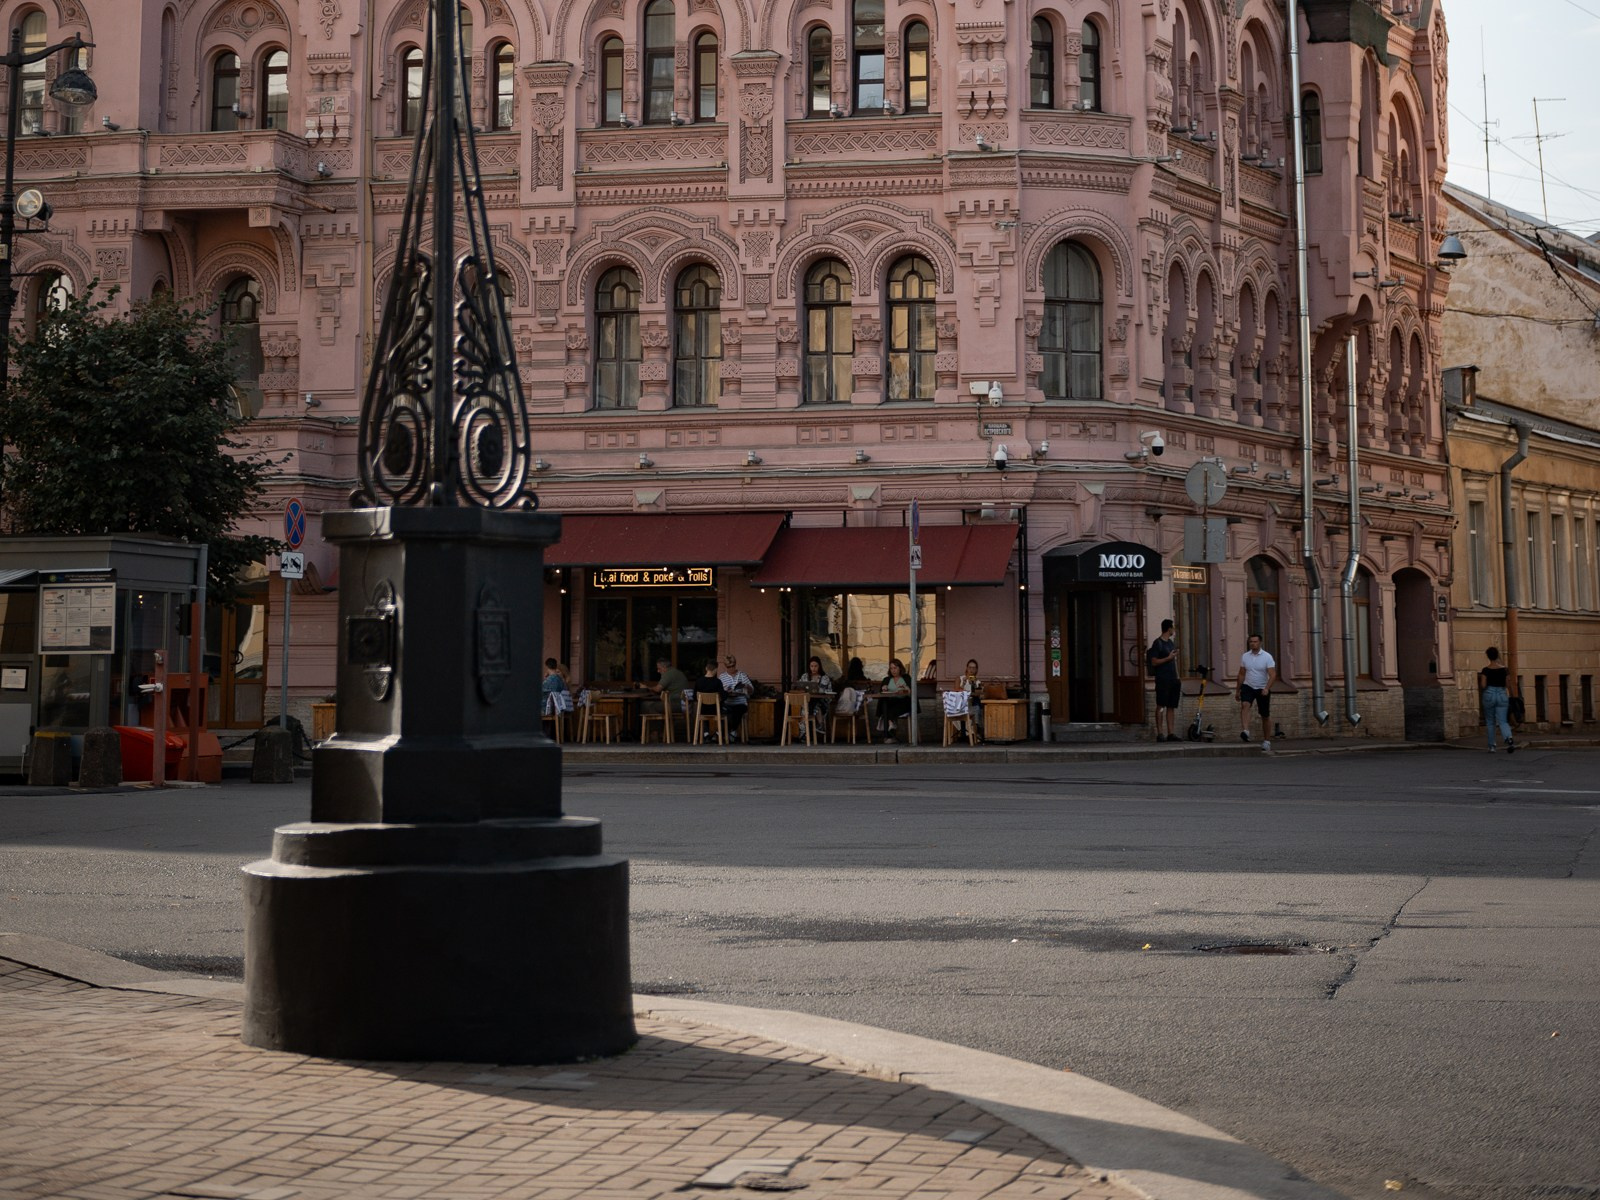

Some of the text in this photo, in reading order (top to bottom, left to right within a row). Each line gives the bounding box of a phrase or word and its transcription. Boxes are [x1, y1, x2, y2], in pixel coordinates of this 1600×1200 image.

[1099, 554, 1145, 569] MOJO
[600, 572, 617, 582] tai
[620, 572, 638, 582] food
[643, 572, 650, 582] &
[653, 572, 674, 584] poke
[689, 572, 708, 582] rolls
